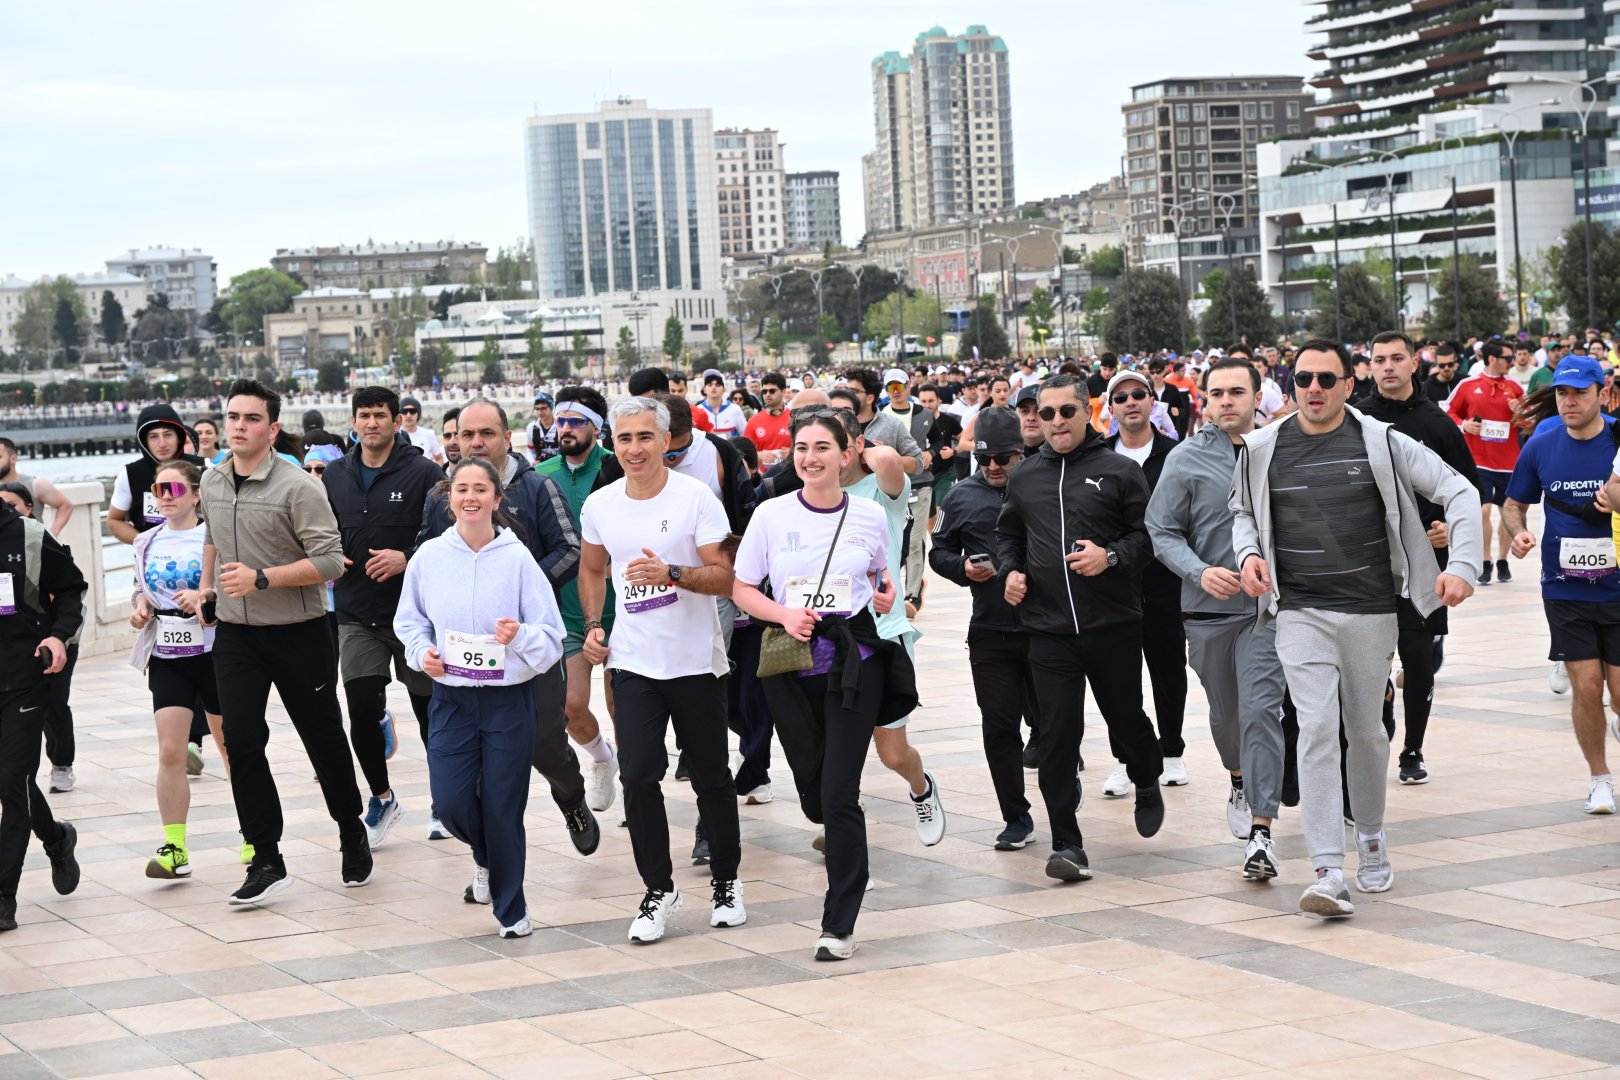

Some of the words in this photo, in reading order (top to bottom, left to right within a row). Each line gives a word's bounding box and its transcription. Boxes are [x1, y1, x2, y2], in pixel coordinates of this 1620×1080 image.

[1485, 428, 1505, 437] 5570
[1572, 490, 1594, 498] Ready
[1568, 554, 1608, 567] 4405
[802, 593, 836, 608] 702
[163, 631, 192, 644] 5128
[463, 651, 484, 667] 95
